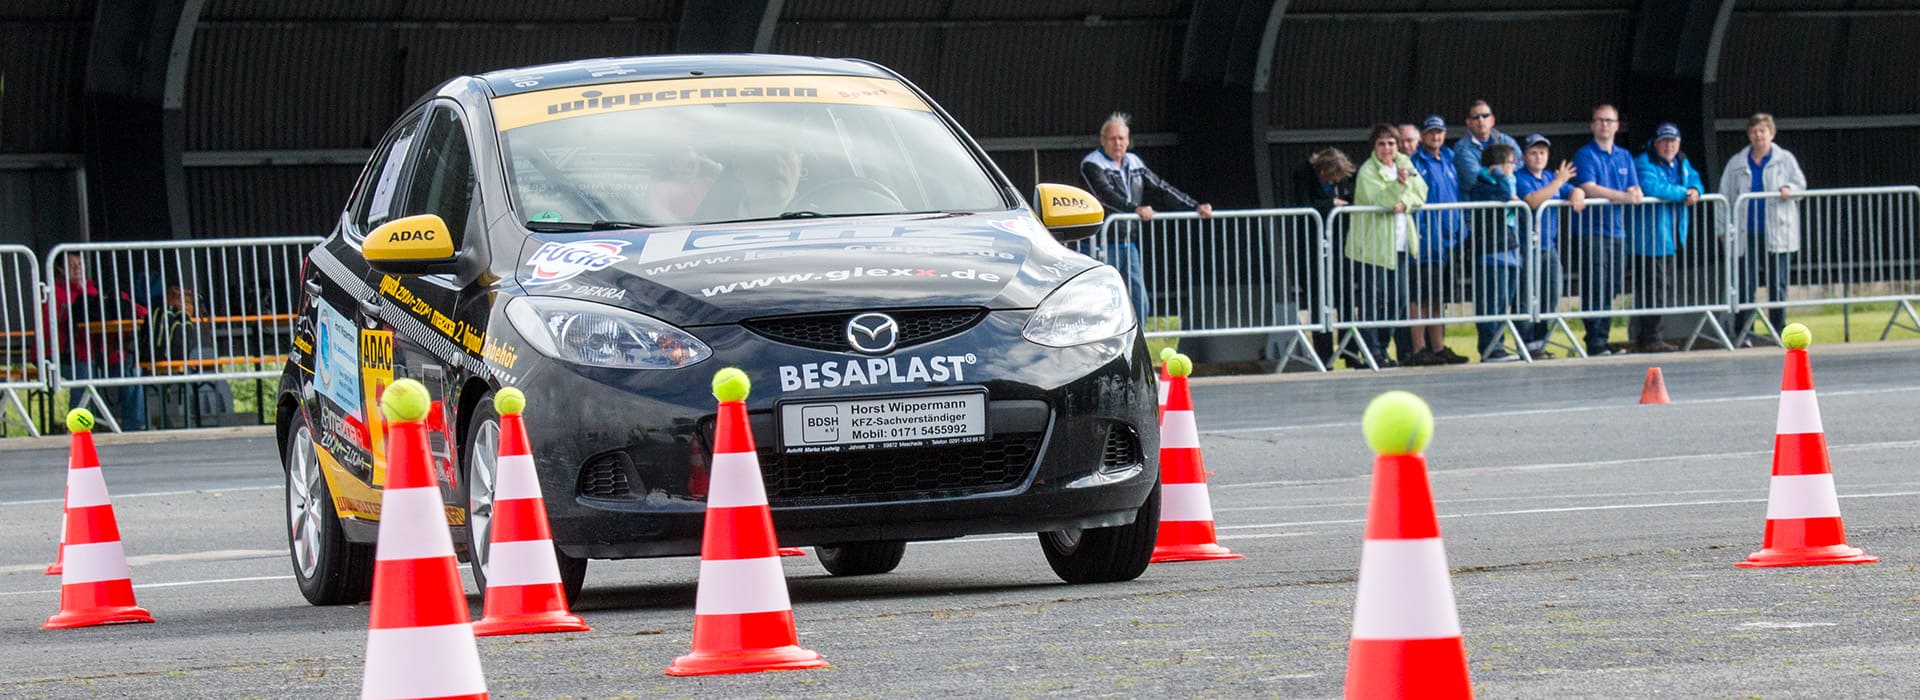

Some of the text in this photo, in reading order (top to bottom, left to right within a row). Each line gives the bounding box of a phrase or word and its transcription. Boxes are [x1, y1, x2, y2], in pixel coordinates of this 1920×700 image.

[547, 86, 817, 115] wippermann
[388, 230, 436, 243] ADAC
[533, 243, 619, 268] FUCHS
[701, 266, 1001, 298] www.glexx.de
[573, 284, 627, 301] DEKRA
[454, 320, 464, 342] 2
[363, 334, 392, 371] ADAC
[851, 399, 967, 415] Horst Wippermann
[808, 417, 839, 427] BDSH
[851, 411, 966, 427] KFZ-Sachverständiger
[852, 424, 967, 440] Mobil: 0171 5455992
